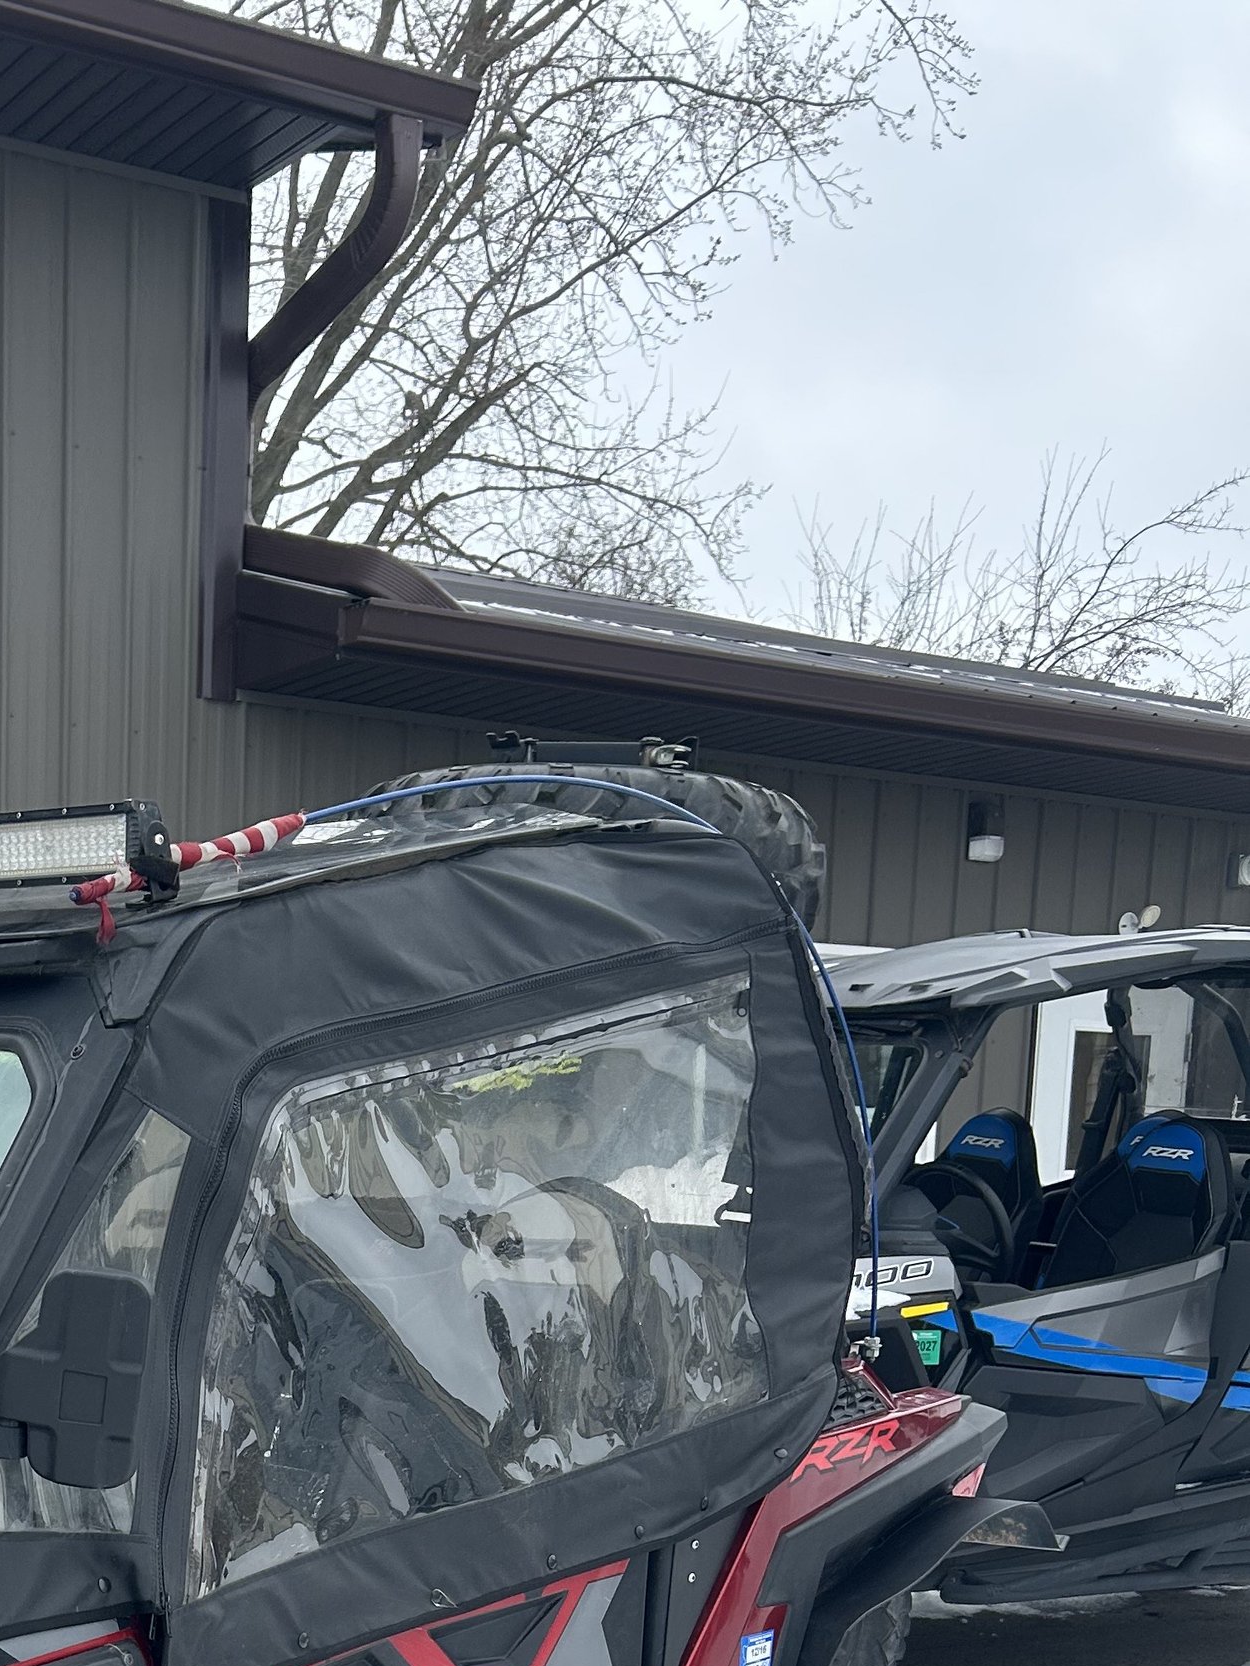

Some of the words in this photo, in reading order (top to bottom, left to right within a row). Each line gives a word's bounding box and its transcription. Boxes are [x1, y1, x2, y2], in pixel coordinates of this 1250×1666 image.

[960, 1134, 1005, 1149] RZR
[1142, 1145, 1194, 1161] RZR
[790, 1419, 900, 1484] RZR
